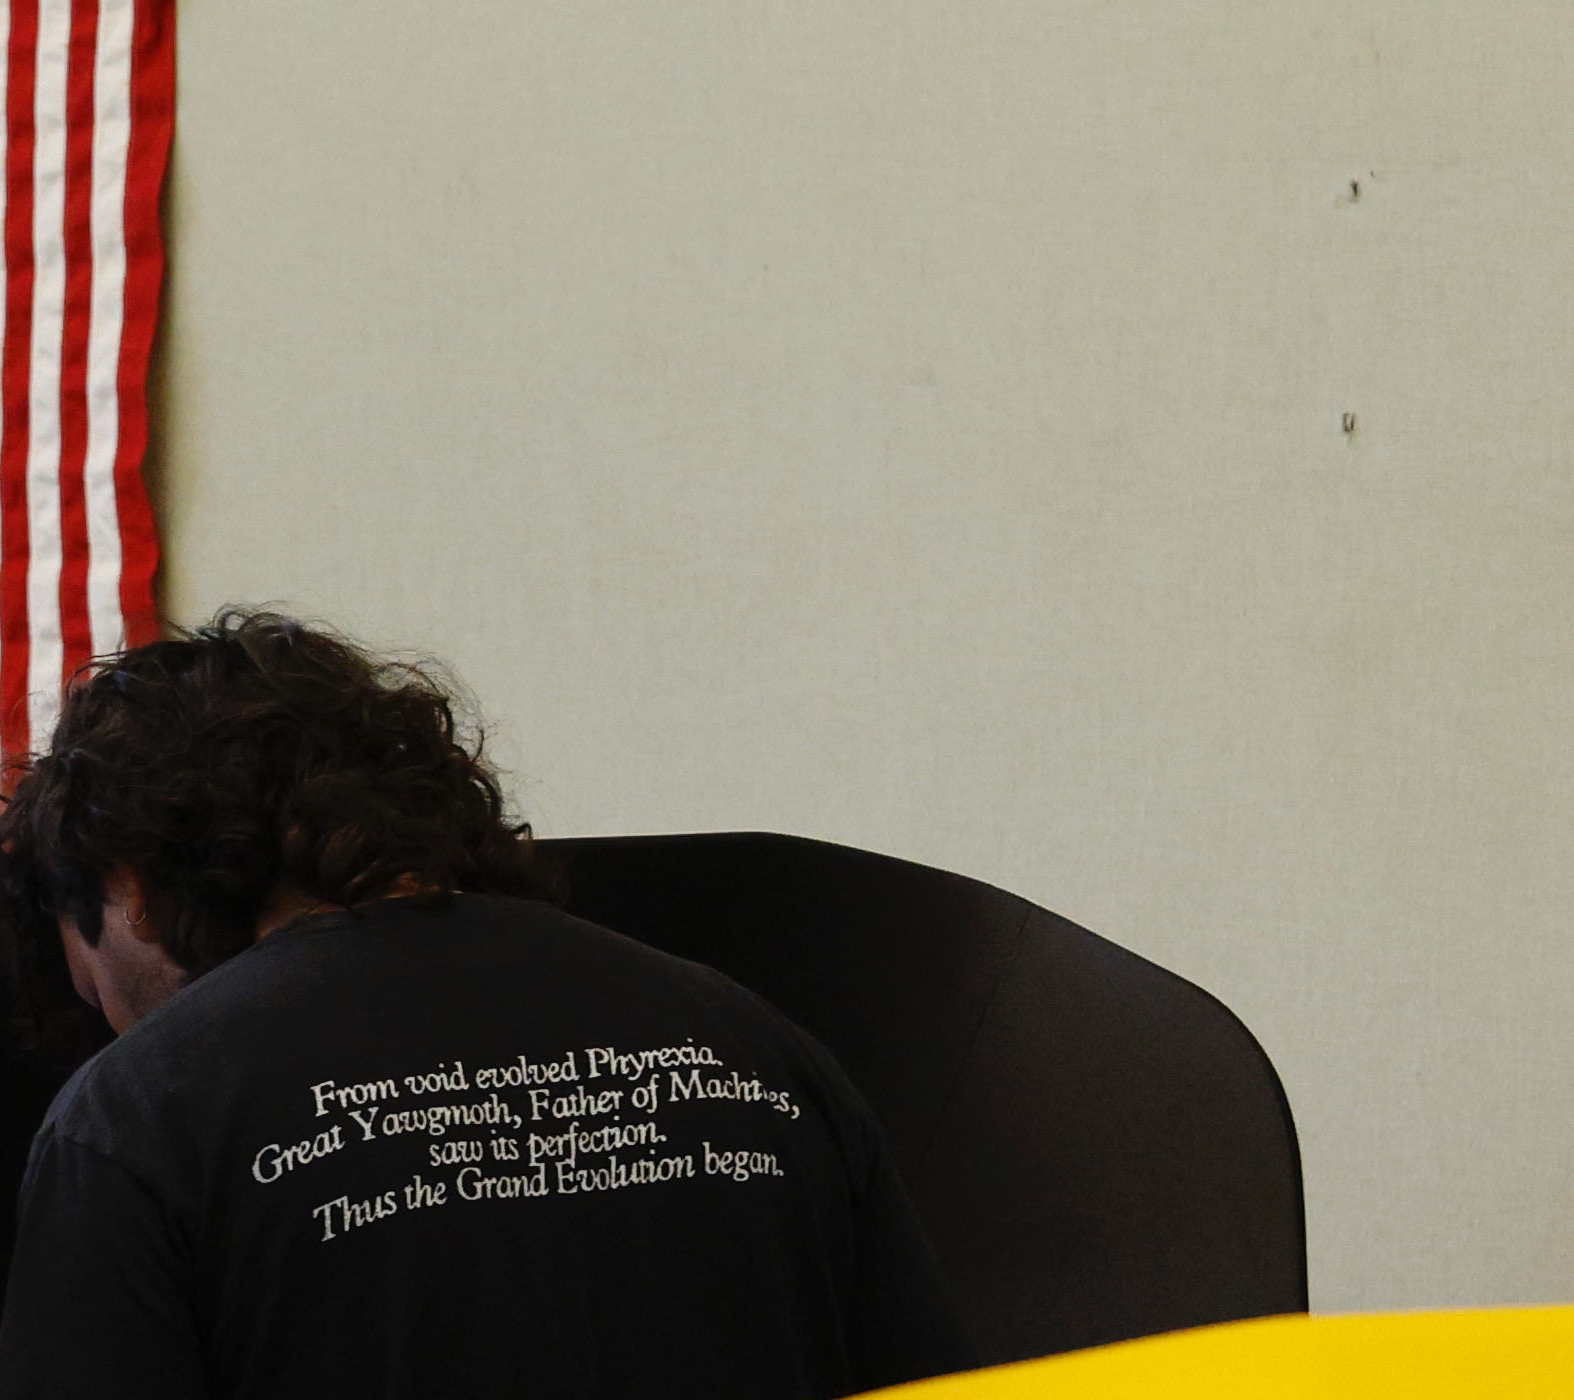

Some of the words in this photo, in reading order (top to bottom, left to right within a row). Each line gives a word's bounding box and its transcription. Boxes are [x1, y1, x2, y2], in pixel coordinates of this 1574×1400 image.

[312, 1080, 399, 1117] From
[404, 1061, 469, 1094] void
[476, 1052, 580, 1088] evolved
[585, 1038, 723, 1083] Phyrexia.
[252, 1125, 345, 1183] Great
[349, 1094, 523, 1143] Yawgmoth,
[528, 1086, 623, 1120] Father
[628, 1069, 659, 1113] of
[430, 1141, 483, 1166] saw
[490, 1137, 519, 1160] its
[527, 1119, 667, 1166] perfection.
[313, 1191, 397, 1241] Thus
[404, 1175, 446, 1209] the
[457, 1160, 549, 1200] Grand
[556, 1150, 695, 1194] Evolution
[703, 1142, 783, 1181] began.
